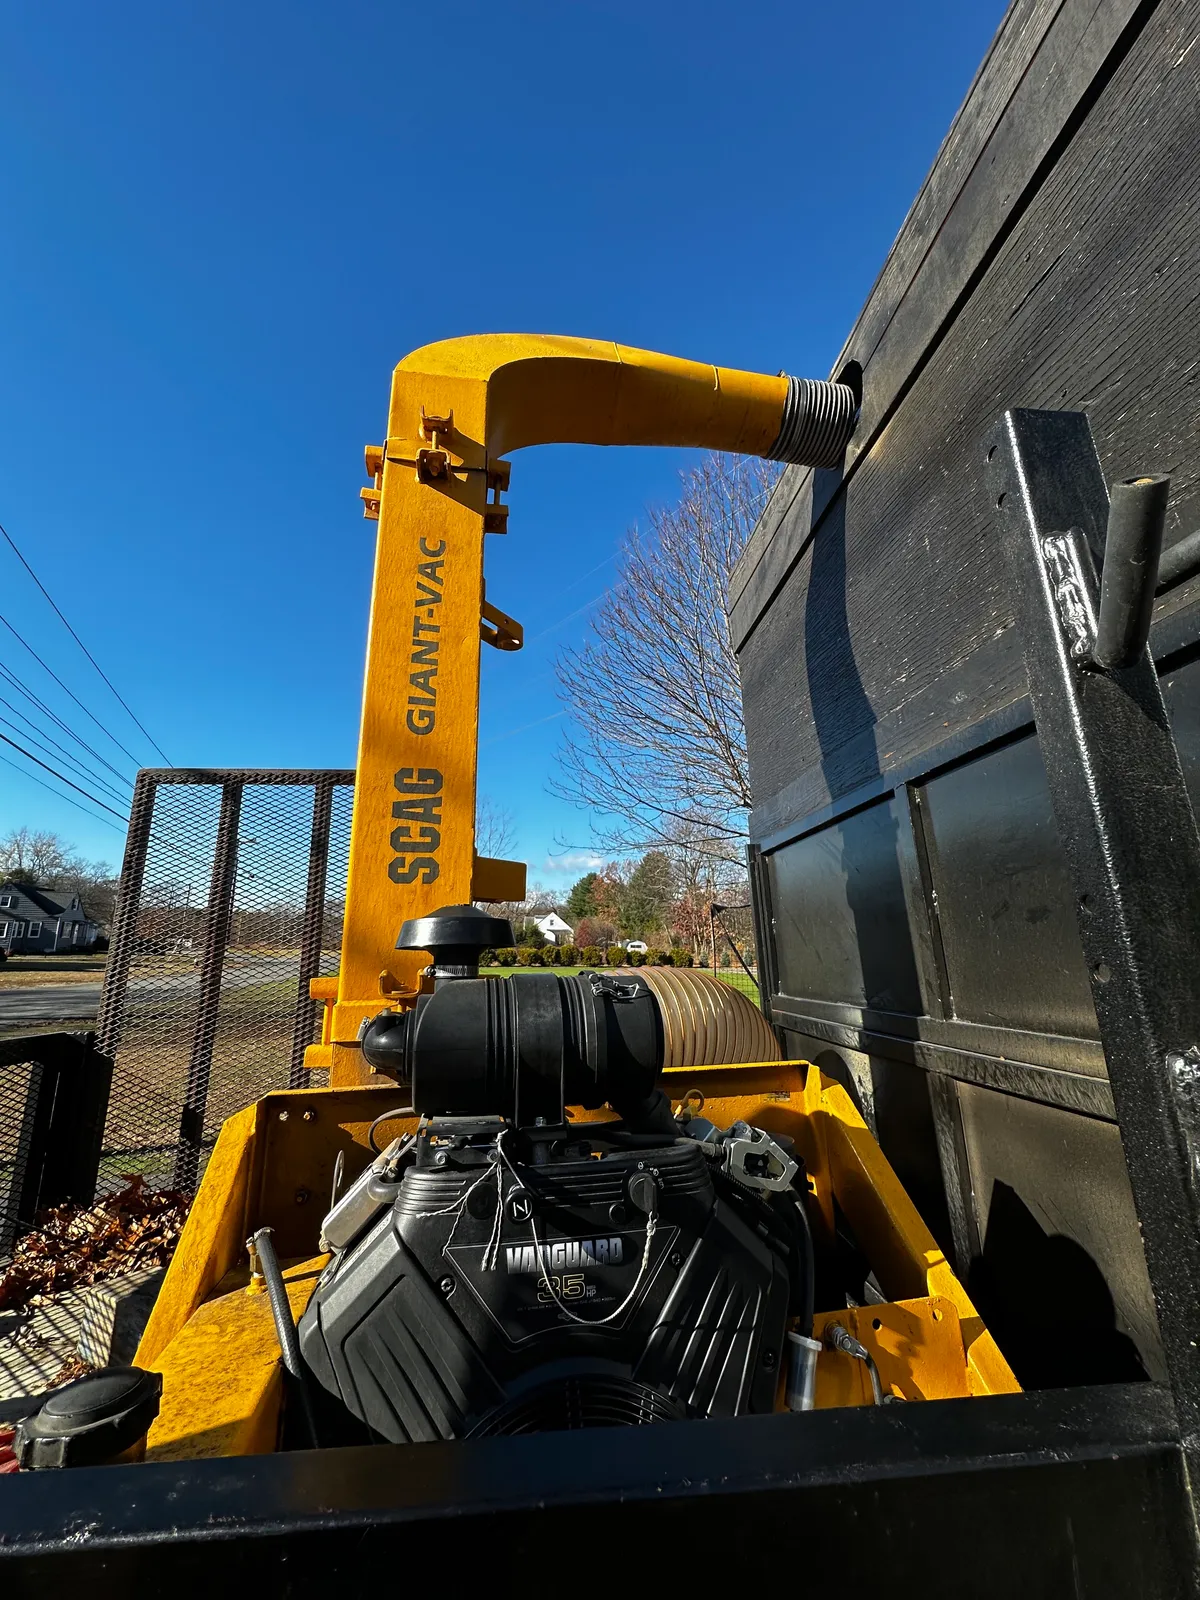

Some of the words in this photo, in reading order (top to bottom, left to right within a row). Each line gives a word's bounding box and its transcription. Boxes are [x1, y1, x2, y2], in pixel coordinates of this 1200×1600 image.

[406, 536, 447, 736] GIANT-VAC
[387, 767, 444, 885] SCAG
[506, 1237, 623, 1275] VANGUARD
[537, 1273, 586, 1303] 35
[586, 1289, 597, 1298] HP
